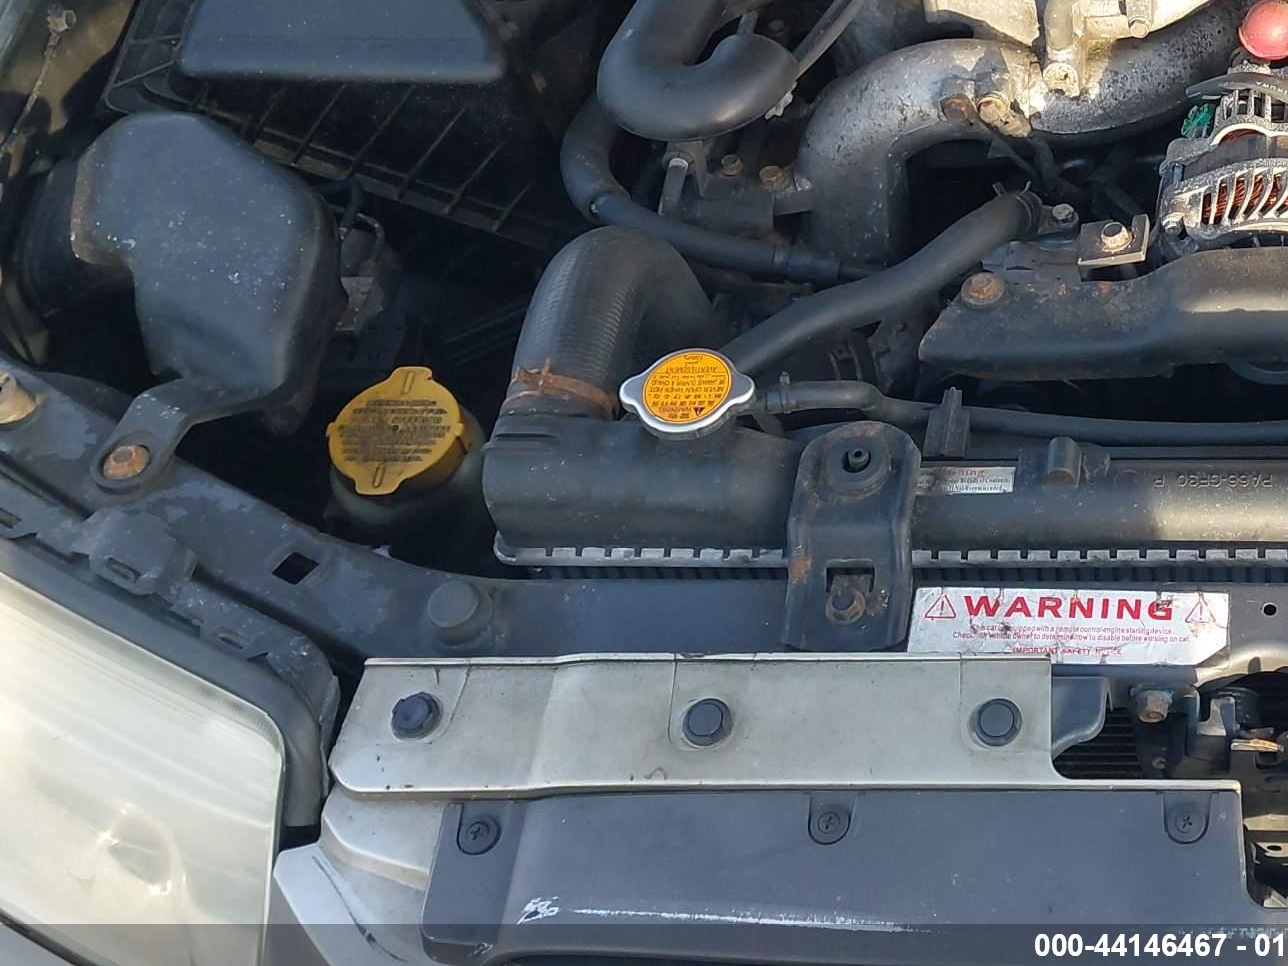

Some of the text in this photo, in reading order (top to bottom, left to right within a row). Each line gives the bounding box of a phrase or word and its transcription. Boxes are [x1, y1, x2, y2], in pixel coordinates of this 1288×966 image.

[964, 594, 1174, 621] WARNING
[1080, 625, 1102, 633] control
[1103, 627, 1126, 635] engine
[1150, 626, 1172, 634] device
[1096, 634, 1121, 642] disable
[1143, 635, 1168, 643] working
